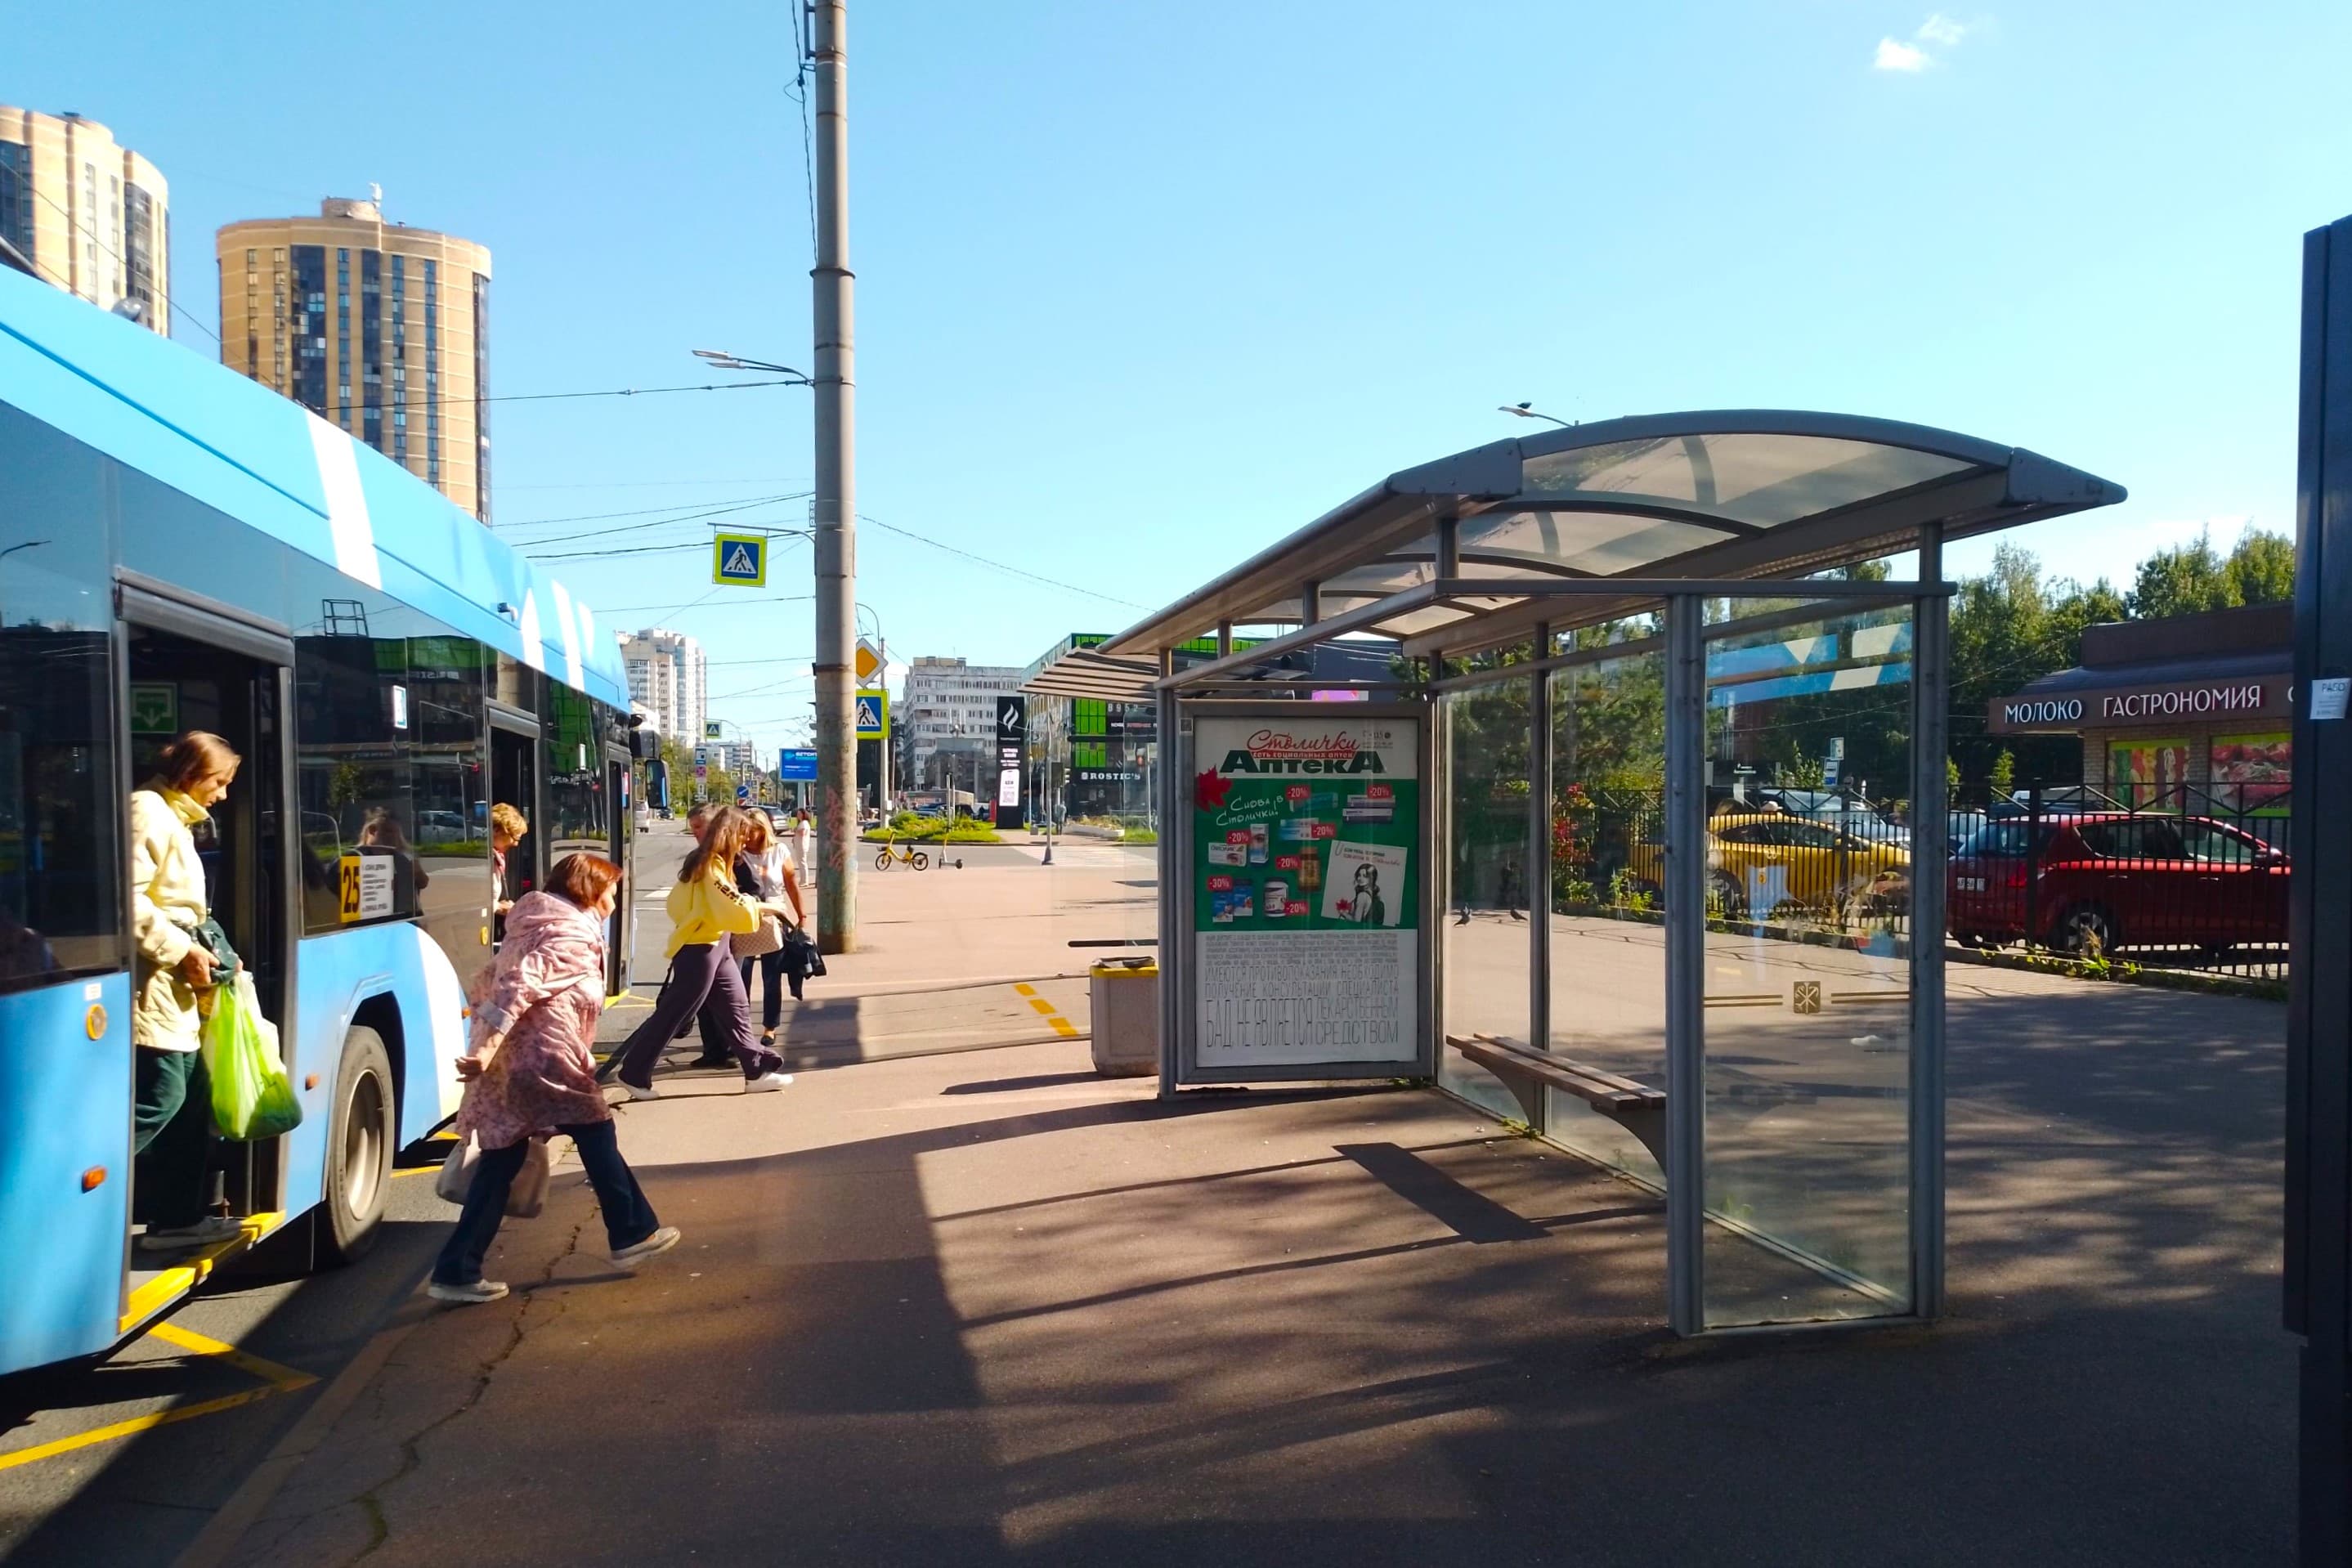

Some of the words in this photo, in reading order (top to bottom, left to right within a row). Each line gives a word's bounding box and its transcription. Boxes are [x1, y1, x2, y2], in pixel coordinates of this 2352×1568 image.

[2005, 699, 2082, 724] МОЛОКО
[2103, 685, 2260, 718] ГАСТРОНОМИЯ
[1247, 729, 1360, 750] Столички
[1090, 772, 1141, 780] ROSTIC'S
[1288, 787, 1307, 797] -20%
[1229, 832, 1249, 842] -20%
[1313, 826, 1334, 836] -20%
[1278, 858, 1299, 867] -20%
[343, 866, 360, 913] 25
[1210, 878, 1230, 888] -30%
[1286, 903, 1306, 913] -20%
[1337, 980, 1399, 996] СПЕЦИАЛИСТА
[1315, 996, 1399, 1019] ЛЕКАРСТВЕННЫМ
[1237, 999, 1251, 1046] НЕ
[1254, 998, 1313, 1046] ЯВЛЯЕТСЯ
[1315, 1020, 1399, 1045] СРЕДСТВОМ
